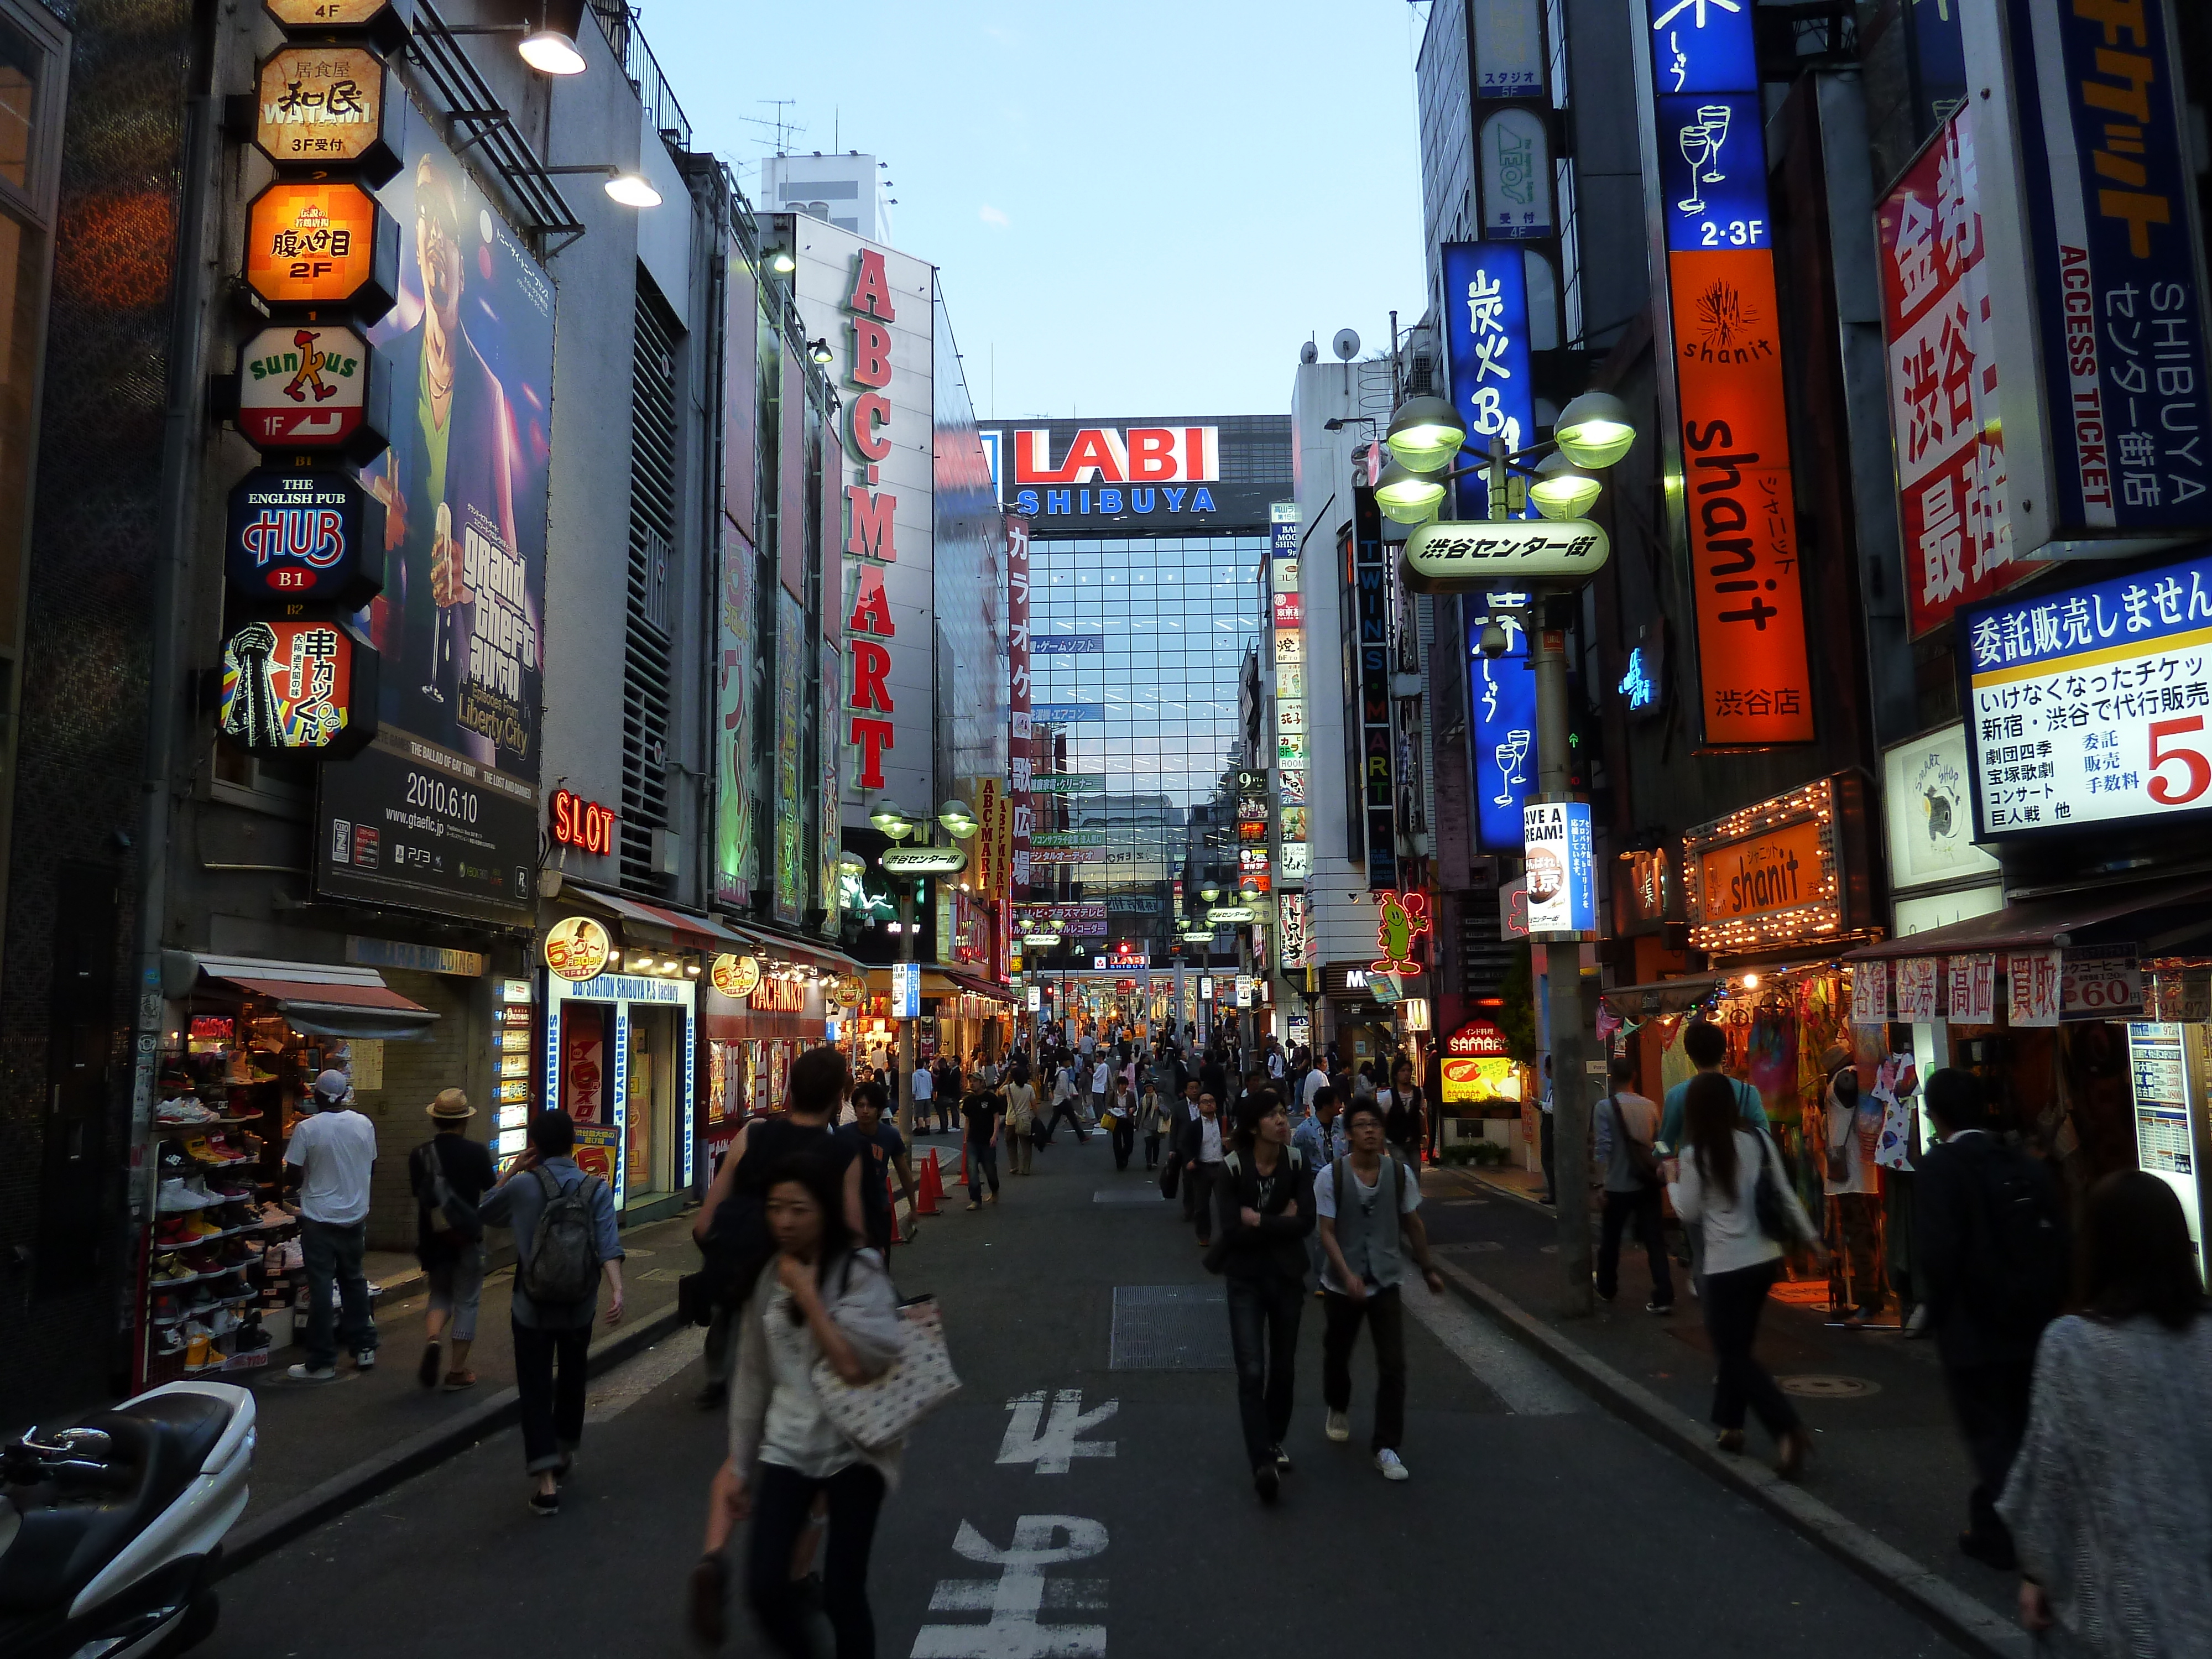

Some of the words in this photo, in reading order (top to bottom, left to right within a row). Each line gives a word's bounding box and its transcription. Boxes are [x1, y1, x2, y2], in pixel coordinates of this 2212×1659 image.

[315, 5, 340, 17] 4F
[294, 61, 351, 78] 居食屋
[1484, 72, 1535, 84] スタジオ
[278, 80, 363, 115] 和民
[1501, 87, 1518, 97] 5F
[263, 102, 371, 124] WATAMI
[292, 138, 344, 152] 3F受付
[1499, 212, 1535, 224] 受付
[1510, 227, 1526, 238] 4F
[270, 229, 351, 258] 腹八分目
[289, 262, 332, 278] 2F
[2059, 244, 2096, 378] ACCESS
[1683, 338, 1773, 364] shanit
[2105, 281, 2162, 508] センター街店
[2149, 281, 2207, 504] SHIBUYA
[264, 416, 285, 436] 1F
[1014, 426, 1220, 485] LABI
[2071, 387, 2112, 509] TICKET
[248, 493, 312, 504] ENGLISH
[316, 493, 346, 504] PUB
[282, 479, 314, 490] THE
[1017, 487, 1217, 516] SHIBUYA
[242, 509, 347, 569] HUB
[1685, 419, 1778, 632] shanit
[1758, 476, 1796, 575] シャニット
[1419, 536, 1599, 559] 渋谷センター街
[278, 572, 304, 587] B1
[1009, 526, 1031, 698] カラオケ
[1972, 571, 2212, 668] 委託販売しません
[1715, 687, 1801, 718] 渋谷店
[1981, 681, 2210, 742] 新宿・渋谷で代行販売
[458, 692, 504, 749] Liberty
[504, 715, 529, 757] City
[1279, 748, 1291, 757] 3F
[1985, 740, 2053, 765] 劇団四季
[2081, 729, 2119, 752] 委託
[2146, 714, 2212, 806] 5
[410, 740, 421, 758] THE
[422, 744, 443, 766] BALLAD
[444, 754, 452, 769] OF
[452, 756, 462, 772] GAY
[462, 760, 476, 779] TONY
[483, 769, 492, 784] THE
[493, 773, 505, 789] LOST
[1987, 760, 2055, 786] 宝塚歌劇
[2084, 752, 2121, 773] 販売
[406, 772, 478, 823] 2010.6.10
[1282, 796, 1293, 805] 2F
[1989, 782, 2054, 805] コンサート
[2085, 770, 2140, 795] 手数料
[386, 807, 445, 836] www.gtaeflc.jp
[554, 788, 615, 857] SLOT
[1012, 757, 1031, 886] 歌広場
[1551, 808, 1562, 823] A
[1991, 805, 2041, 827] 巨人戦
[2054, 801, 2072, 820] 他
[408, 847, 431, 864] PS3
[886, 854, 961, 864] 渋谷センター街
[1747, 841, 1778, 865] シャニット
[1731, 848, 1799, 912] shanit
[1208, 911, 1252, 919] 渋谷センター街
[617, 977, 645, 1000] SHIBUYA
[658, 983, 679, 1003] factory
[752, 976, 805, 1013] PACHINKO
[1854, 962, 1886, 1017] 各種
[1897, 962, 1933, 1018] 金券
[1950, 954, 1992, 1017] 高価
[2010, 955, 2057, 1020] 買取
[2081, 979, 2129, 1007] 60
[2130, 992, 2141, 1004] 円
[684, 1016, 693, 1094] SHIBUYA
[1450, 1036, 1509, 1051] SAMRA
[615, 1015, 626, 1104] SHIBUYA
[684, 1129, 692, 1175] BASE
